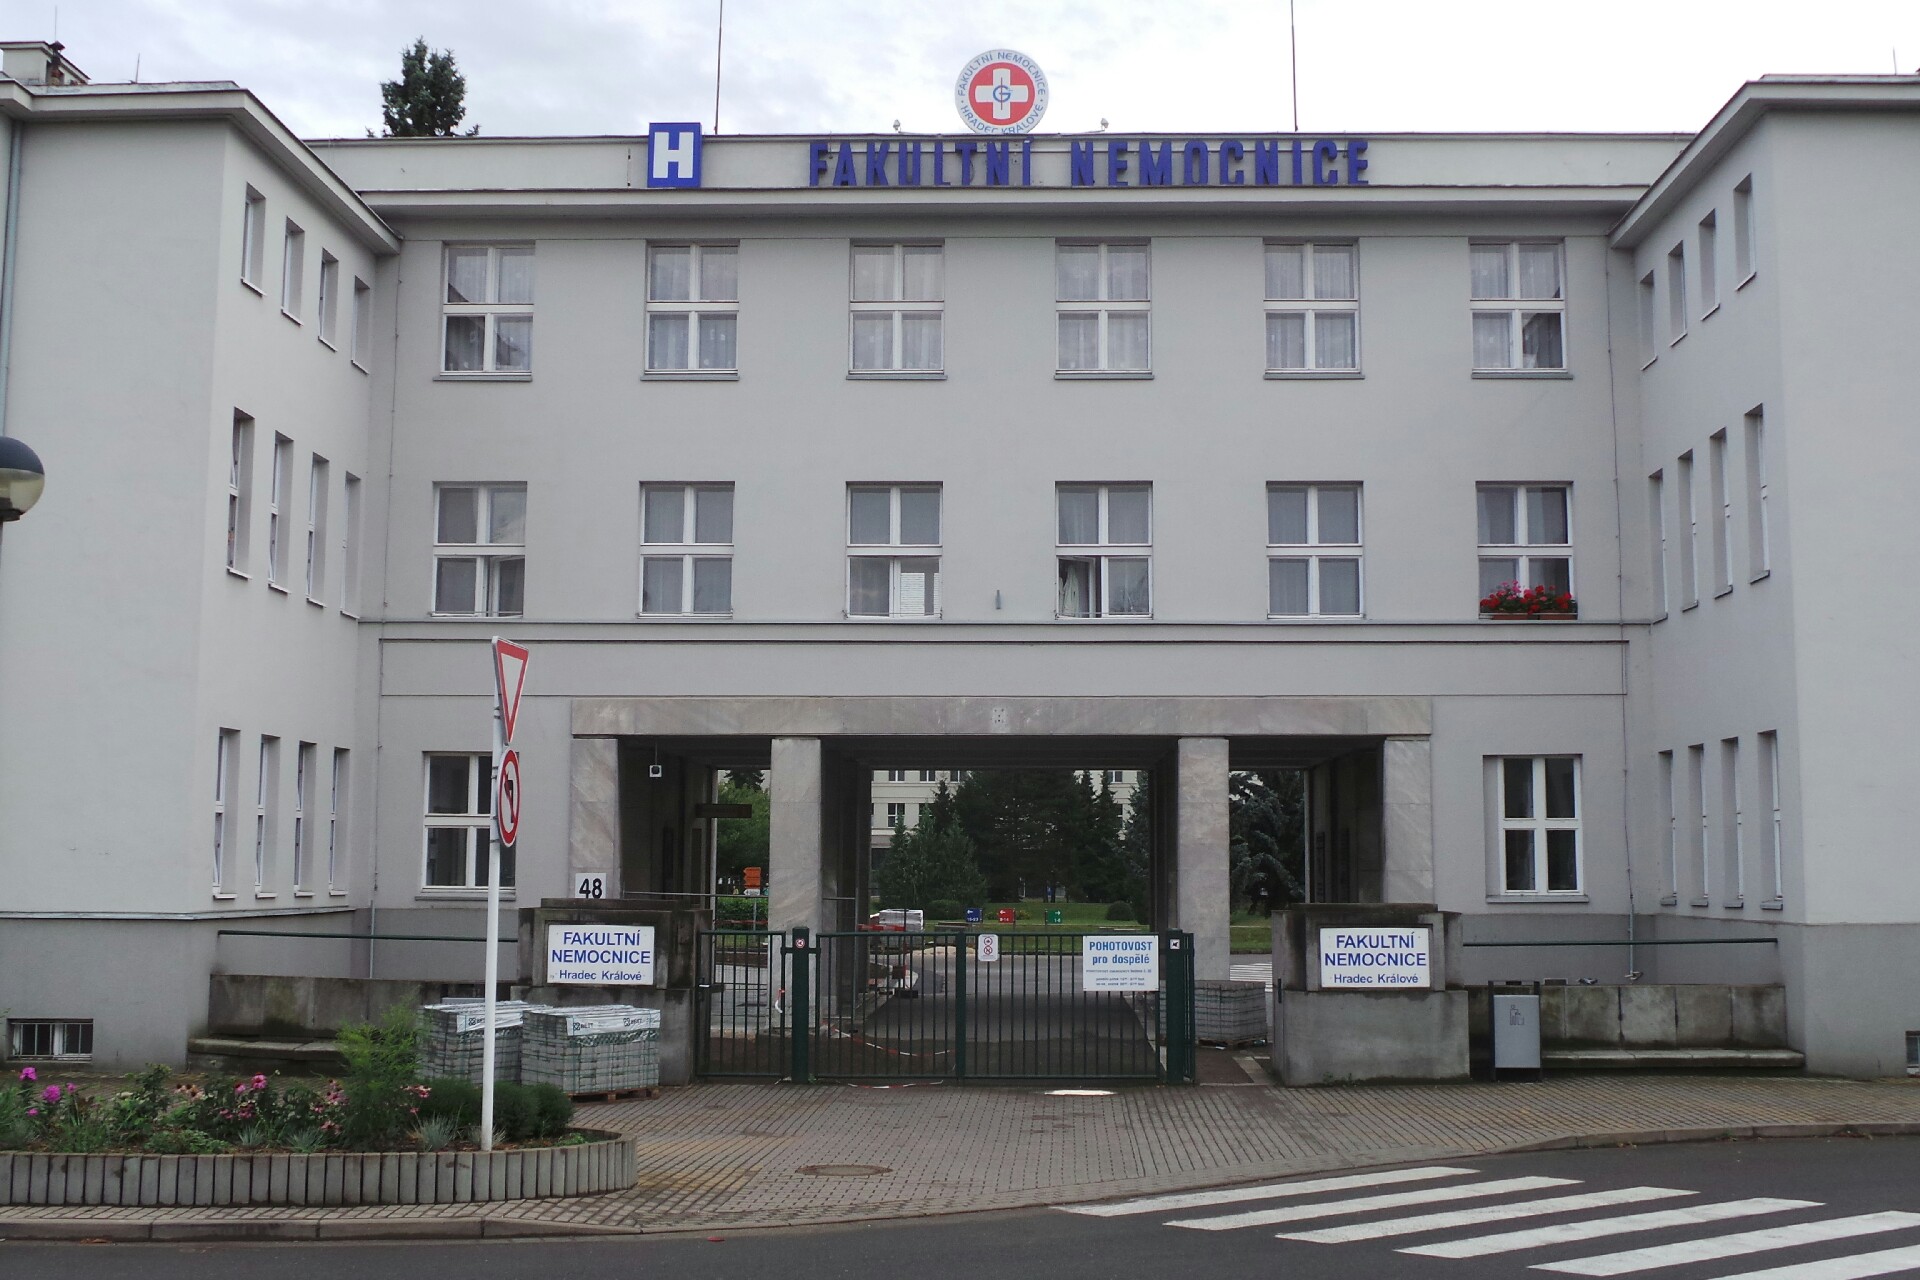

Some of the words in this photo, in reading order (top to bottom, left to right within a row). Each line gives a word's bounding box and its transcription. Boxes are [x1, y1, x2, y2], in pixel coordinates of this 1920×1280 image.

[957, 53, 993, 97] FAKULTNÍ
[997, 51, 1046, 96] NEMOCNICE
[652, 132, 694, 179] H
[809, 136, 1034, 187] FAKULTNÍ
[1070, 139, 1369, 186] NEMOCNICE
[579, 878, 603, 899] 48
[563, 929, 641, 946] FAKULTNÍ
[1336, 931, 1415, 949] FAKULTNÍ
[1089, 941, 1153, 951] POHOTOVOST
[551, 949, 651, 964] NEMOCNICE
[1092, 956, 1108, 966] pro
[1112, 954, 1150, 966] dospělé
[1324, 952, 1427, 967] NEMOCNICE
[559, 969, 597, 981] Hradec
[601, 970, 642, 981] Králové
[1333, 973, 1373, 984] Hradec
[1377, 973, 1419, 984] Králové
